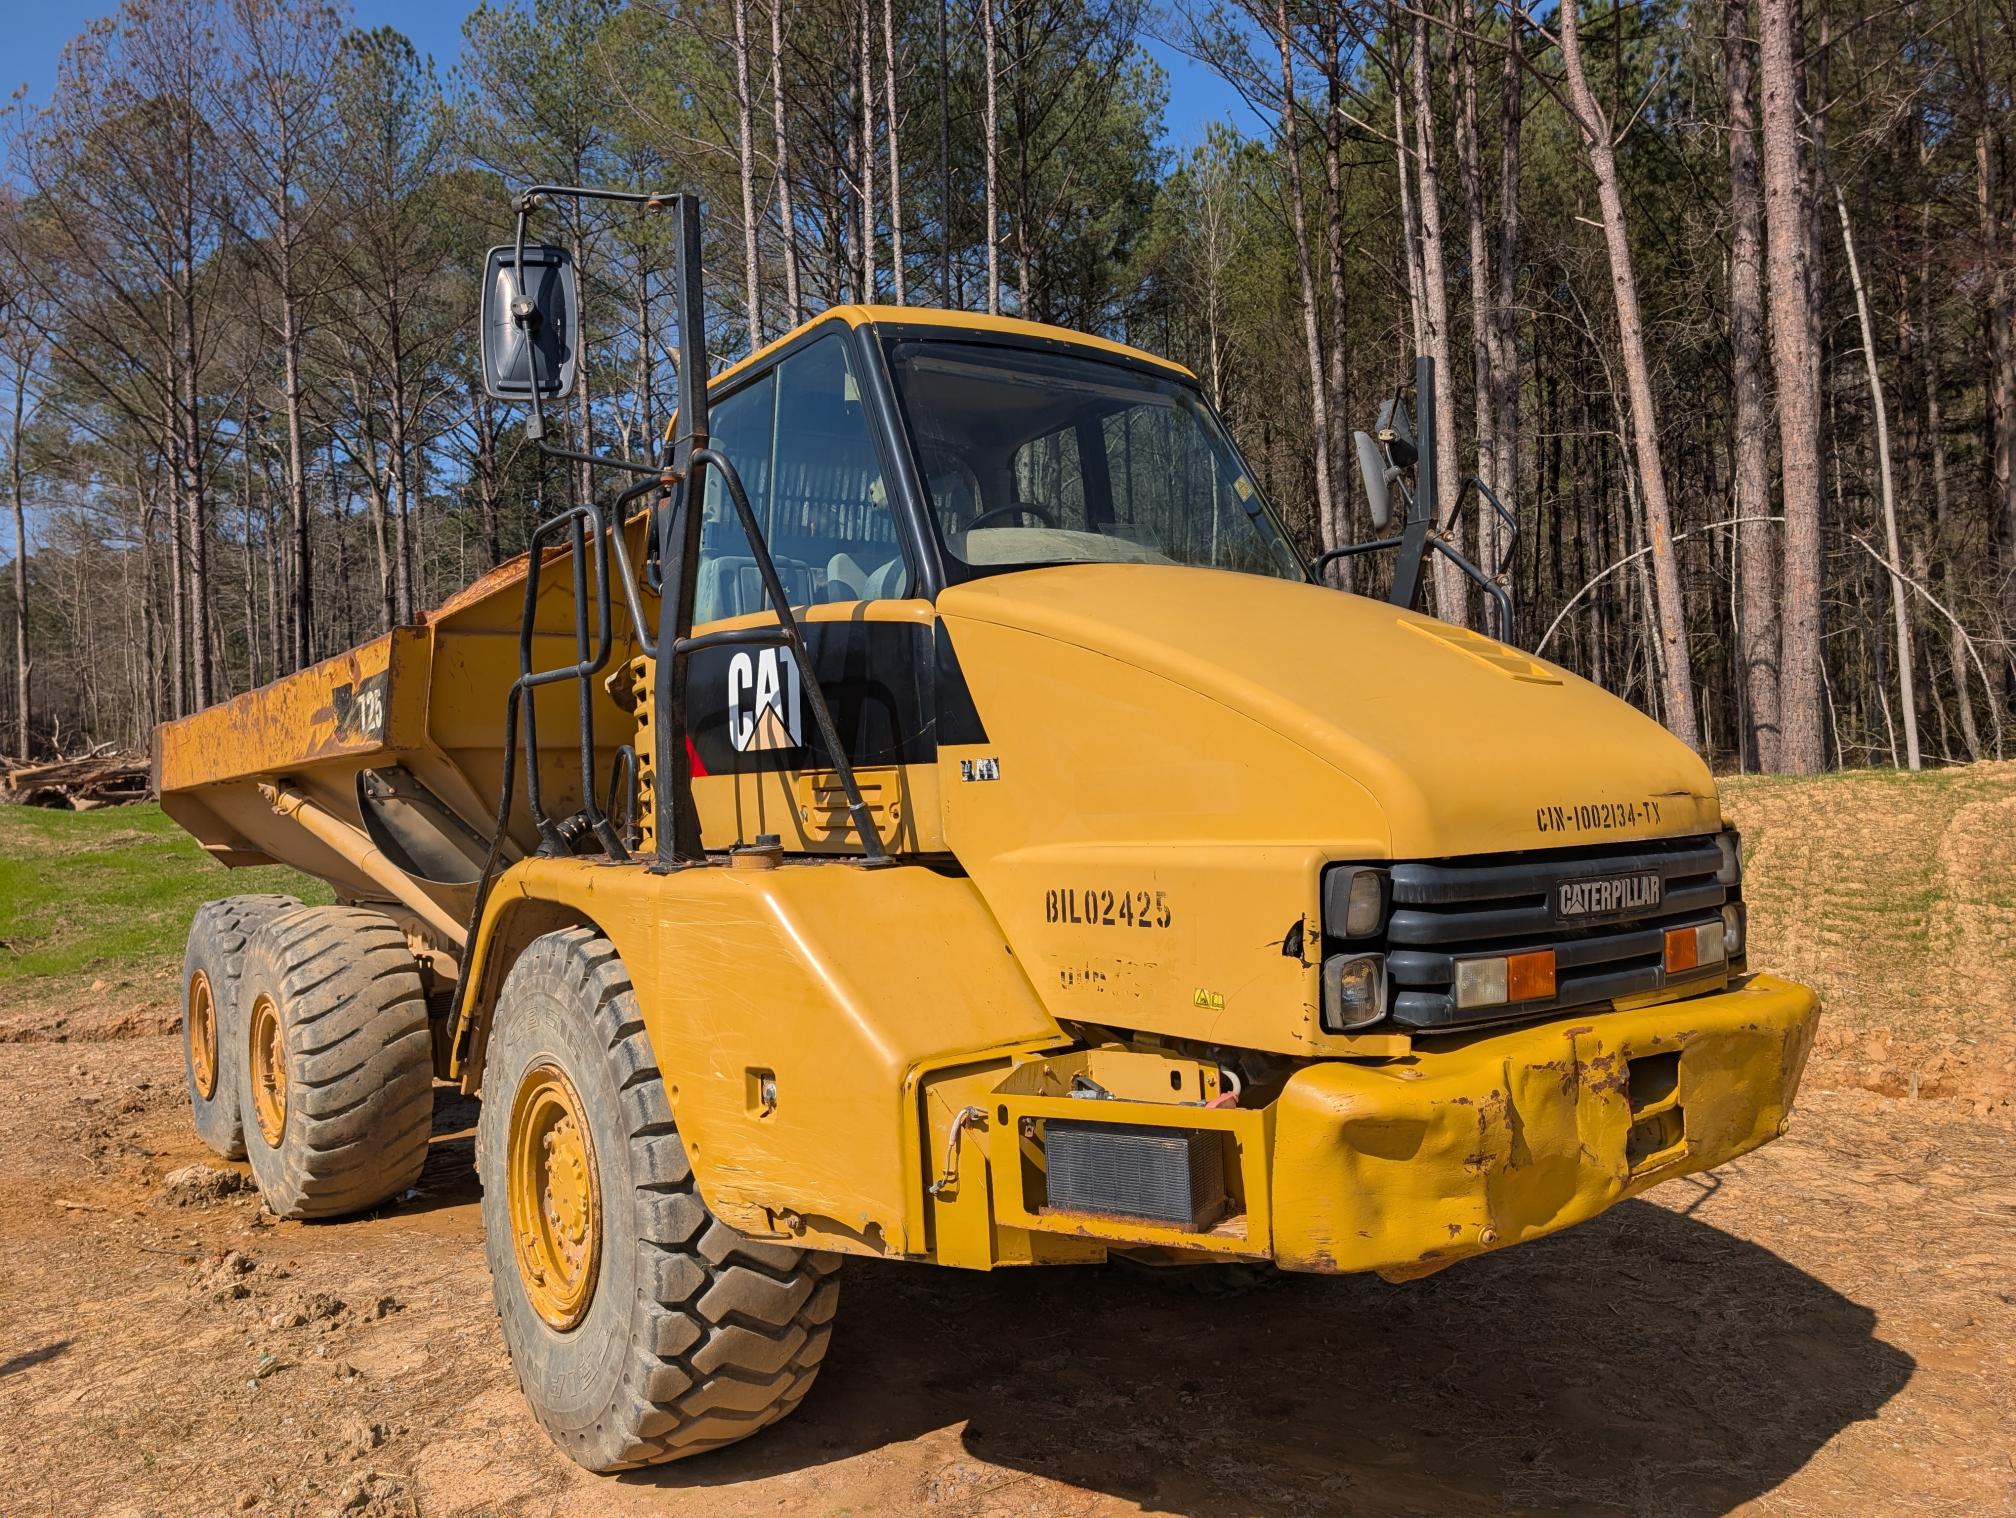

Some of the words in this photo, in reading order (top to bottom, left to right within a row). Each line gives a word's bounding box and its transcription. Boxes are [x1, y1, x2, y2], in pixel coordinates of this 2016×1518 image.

[357, 688, 383, 732] 725
[728, 642, 807, 752] CAT
[1046, 889, 1172, 928] BIL02425
[1560, 876, 1660, 915] CATERPILLAR
